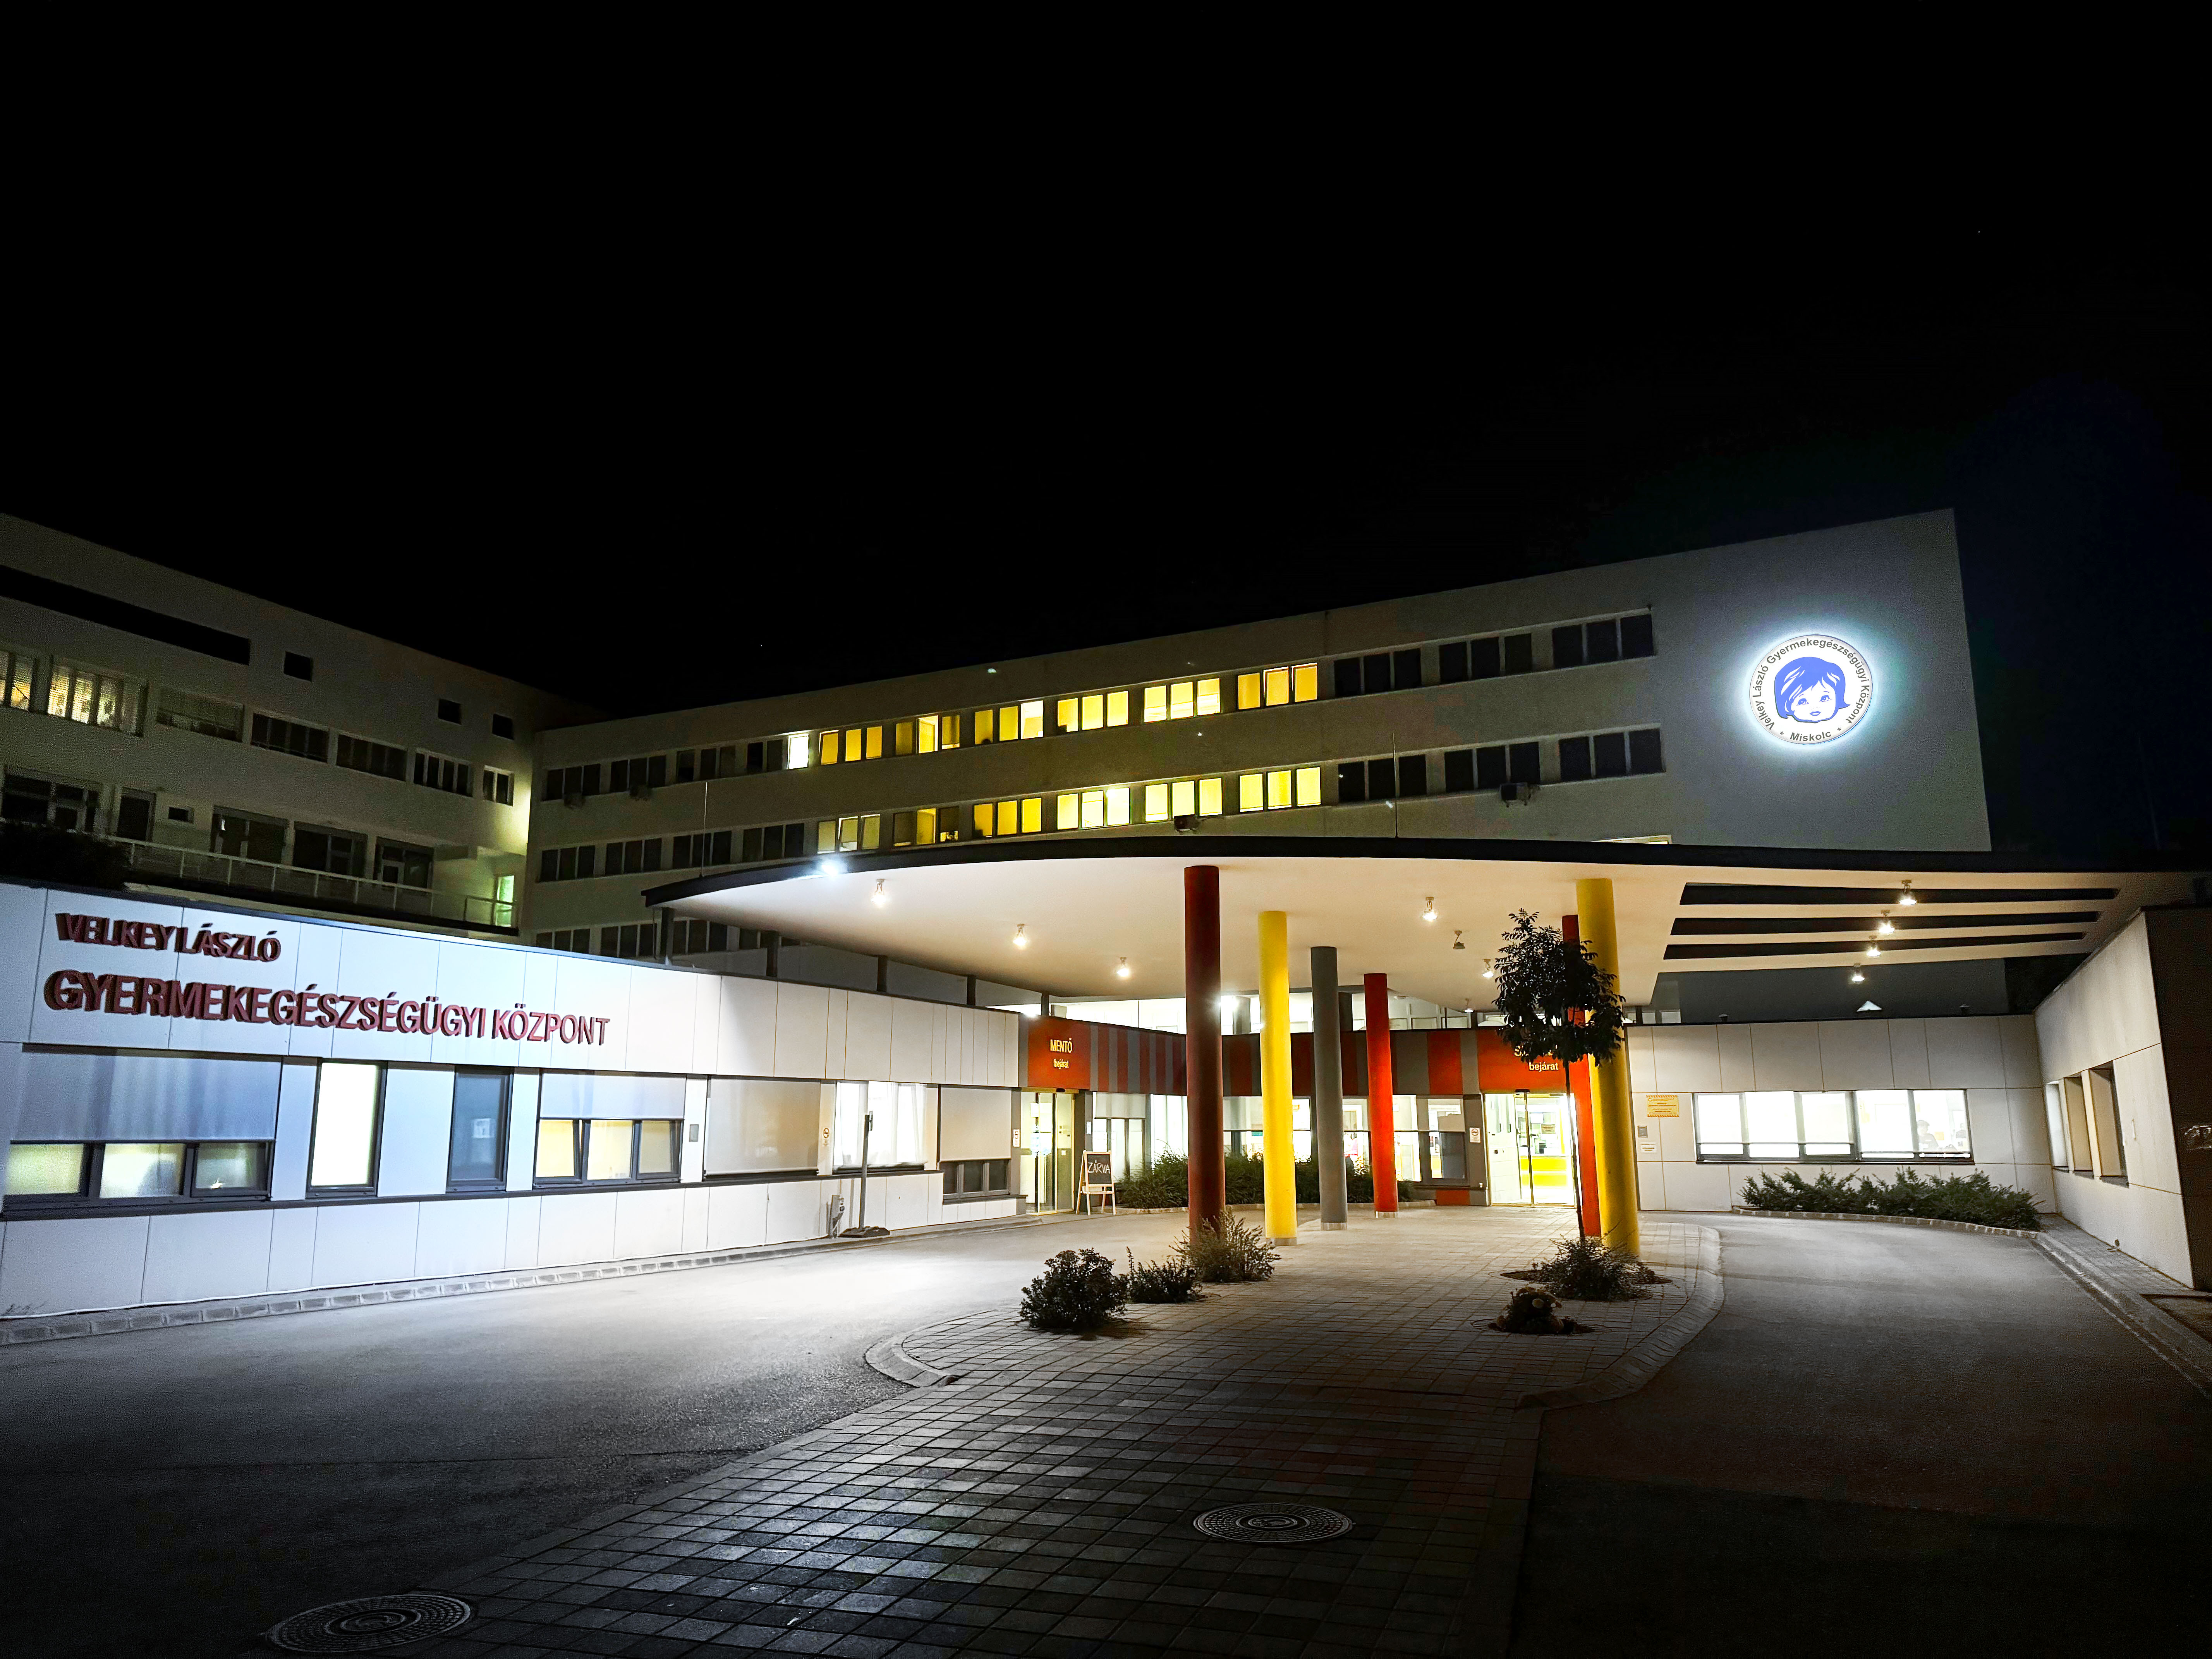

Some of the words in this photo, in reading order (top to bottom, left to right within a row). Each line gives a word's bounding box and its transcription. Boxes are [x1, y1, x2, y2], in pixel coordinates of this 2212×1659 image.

[1766, 638, 1870, 682] Gyermekegészségügyi
[1753, 665, 1769, 697] László
[1755, 701, 1775, 730] Velkey
[1845, 685, 1870, 724] Központ
[1790, 731, 1831, 742] Miskolc
[55, 913, 175, 951] VELKEY
[174, 922, 281, 962] LÁSZLÓ
[43, 969, 486, 1039] GYERMEKEGÉSZSÉGÜGYI
[491, 1003, 611, 1046] KÖZPONT
[1529, 1061, 1559, 1072] bejárat
[1087, 1159, 1111, 1174] ZÁRVA
